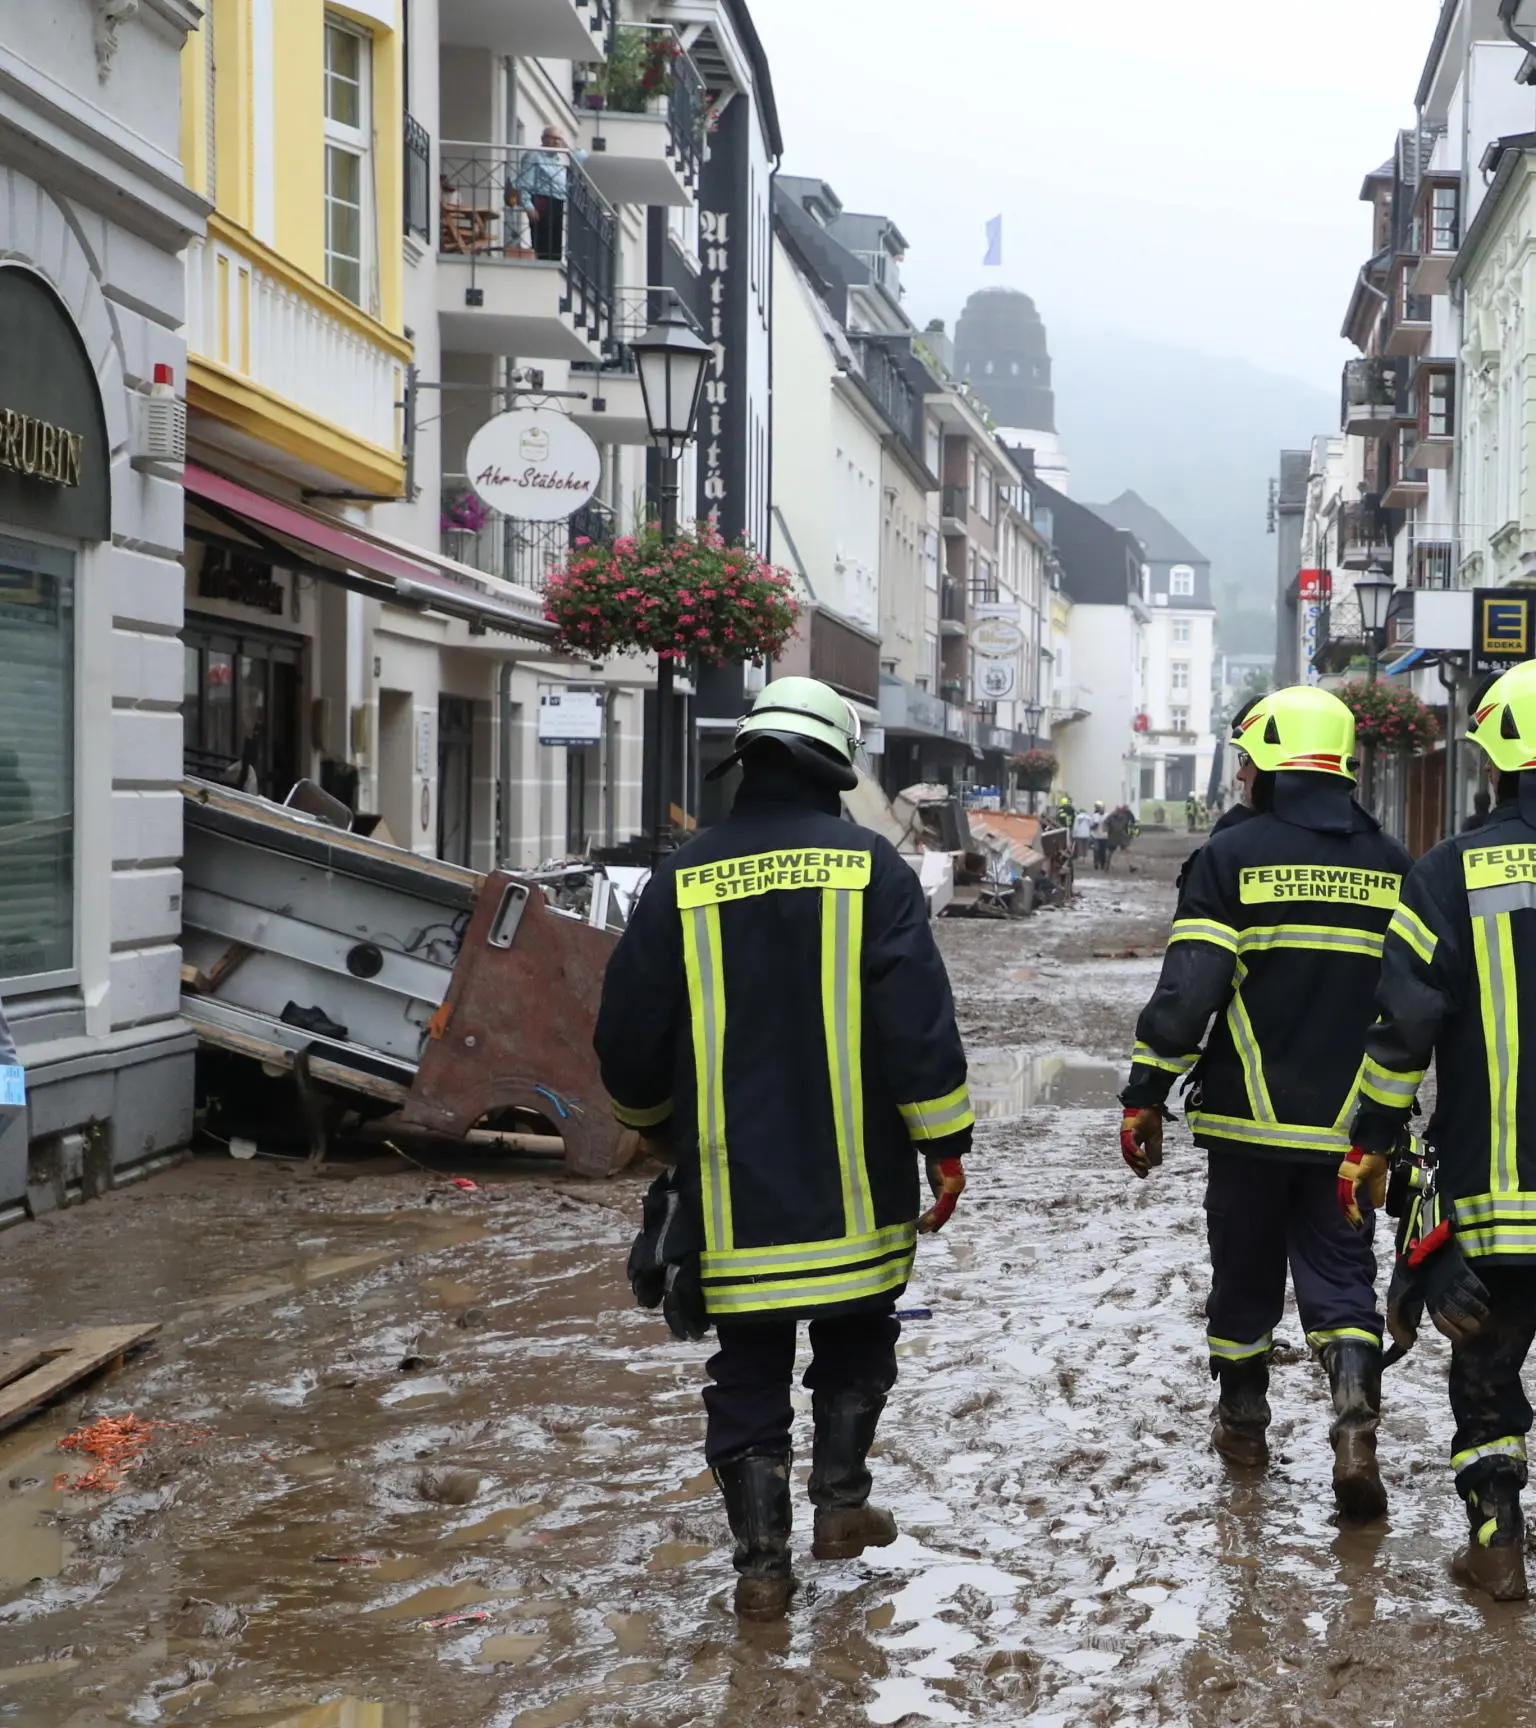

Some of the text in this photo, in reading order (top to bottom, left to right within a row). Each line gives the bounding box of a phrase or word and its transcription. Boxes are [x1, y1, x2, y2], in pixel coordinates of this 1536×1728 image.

[0, 407, 84, 488] RUBIN
[475, 464, 590, 491] Ahr-Stübchen
[1488, 641, 1522, 649] EDEKA
[682, 852, 866, 888] FEUERWEHR
[715, 868, 831, 898] STEINFELD
[1243, 868, 1396, 890] FEUERWEHR
[1274, 883, 1370, 901] STEINFELD
